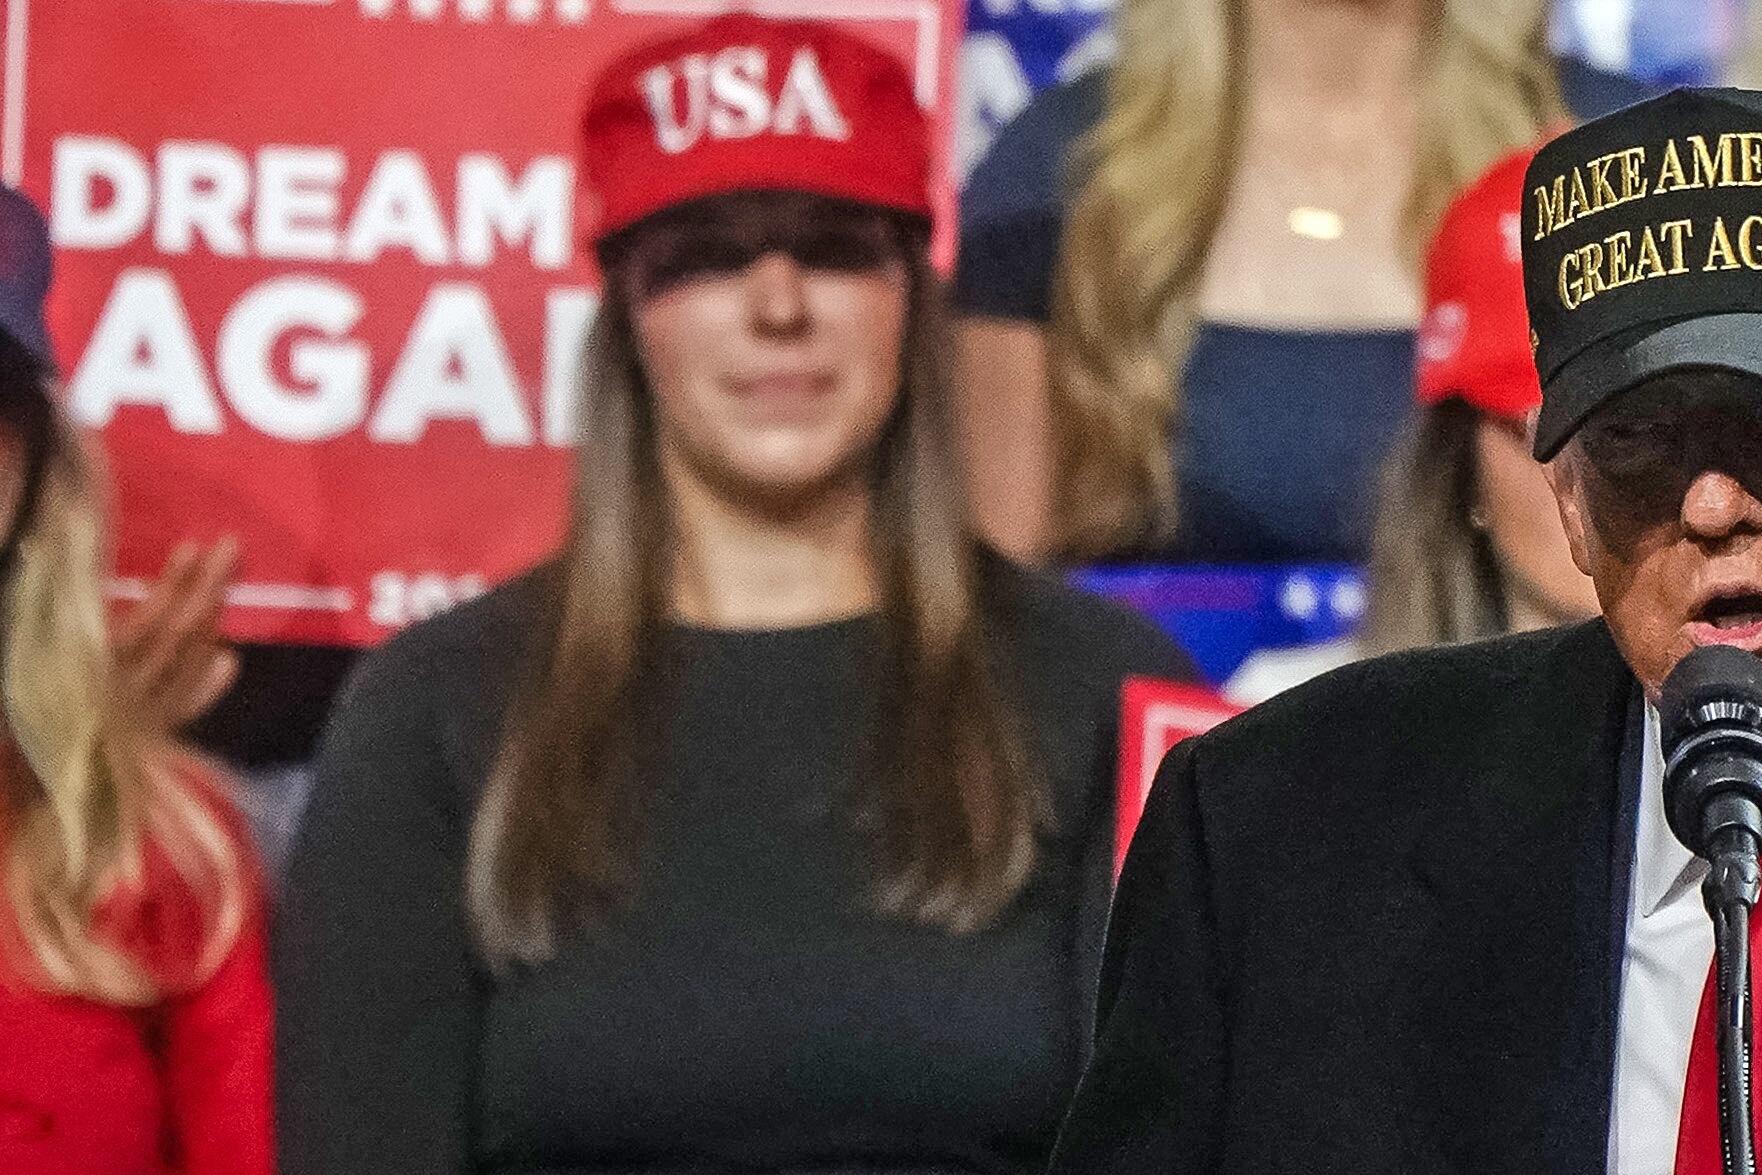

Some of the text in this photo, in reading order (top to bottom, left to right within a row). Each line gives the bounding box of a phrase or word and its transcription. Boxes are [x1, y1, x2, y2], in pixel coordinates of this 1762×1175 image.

[634, 44, 852, 153] USA
[50, 134, 574, 271] DREAM
[1534, 147, 1647, 241] MAKE
[1558, 219, 1694, 310] GREAT
